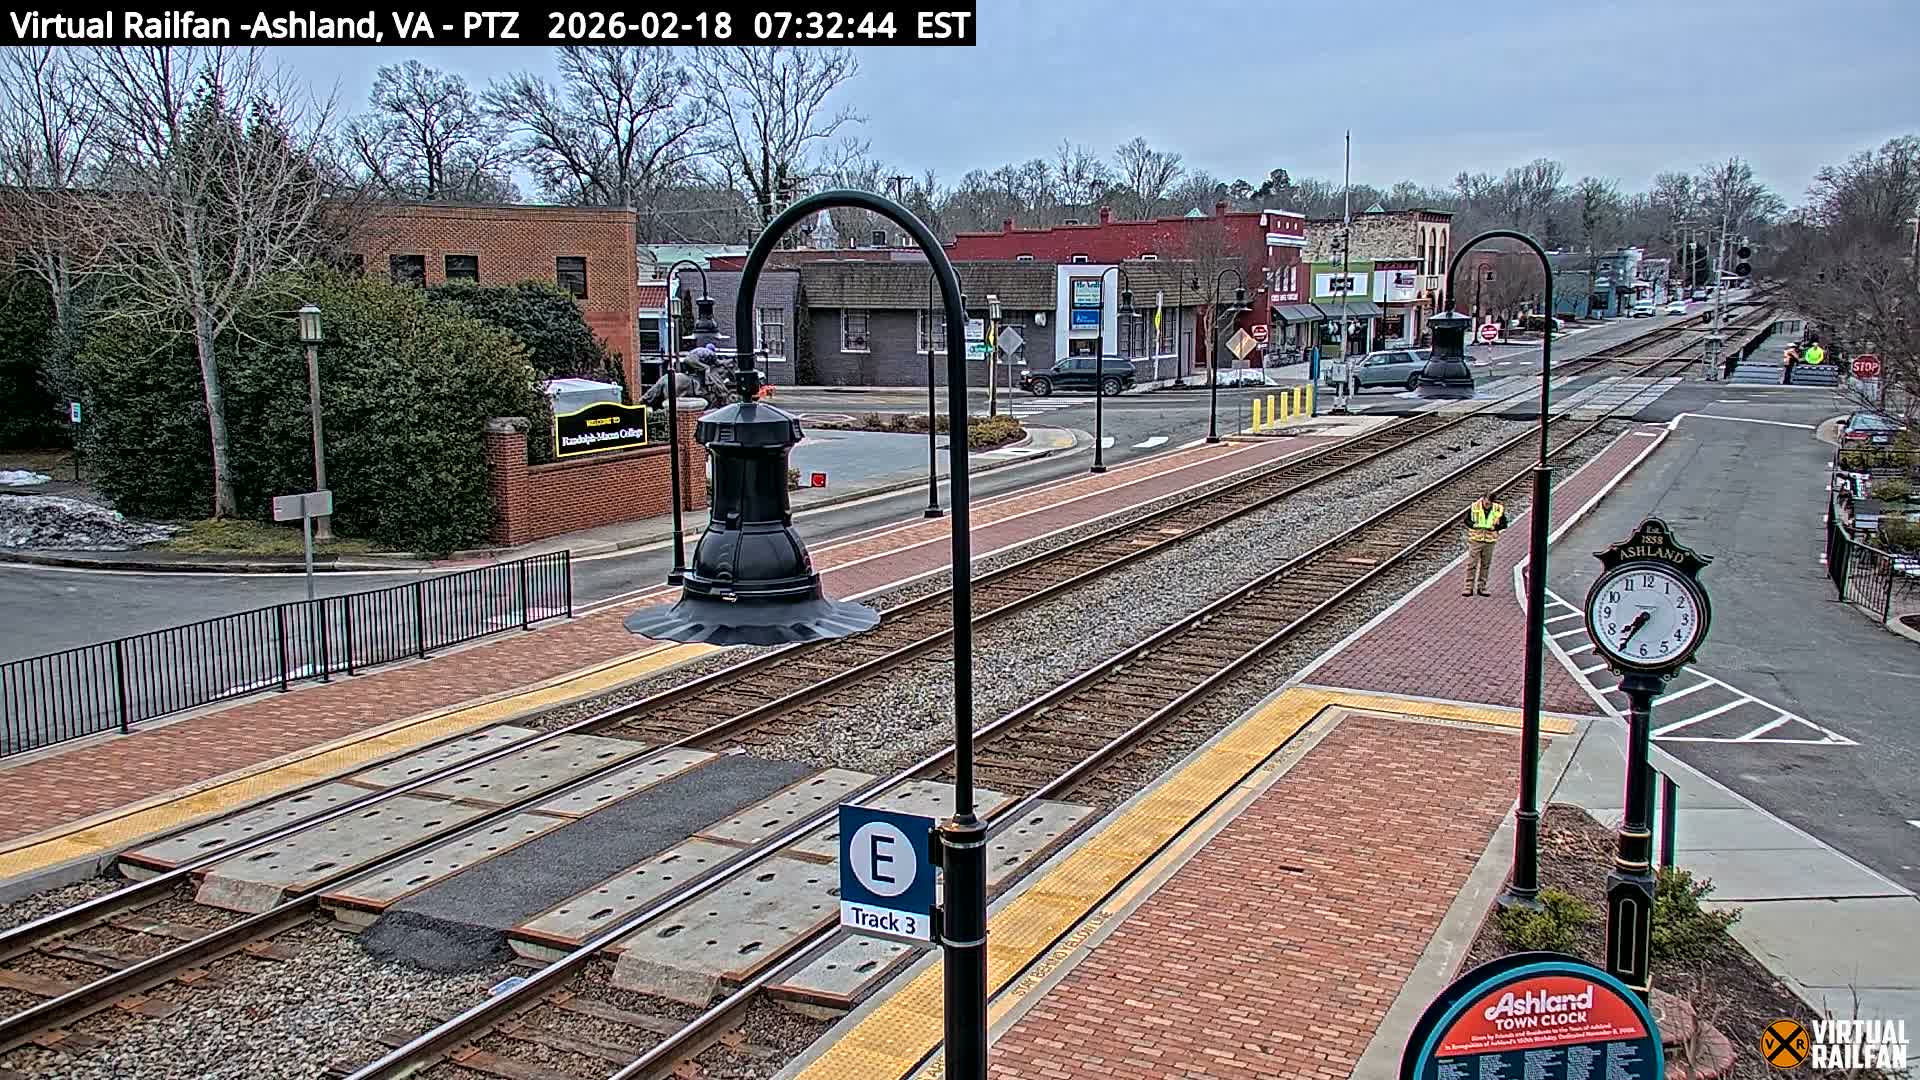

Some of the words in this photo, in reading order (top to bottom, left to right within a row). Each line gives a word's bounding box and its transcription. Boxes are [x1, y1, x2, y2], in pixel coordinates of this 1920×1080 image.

[1852, 361, 1879, 372] STOP
[1641, 535, 1664, 545] 1858
[1619, 546, 1685, 564] ASHLAND
[1625, 578, 1634, 592] 11
[1643, 575, 1655, 588] 12
[1664, 582, 1670, 595] 1
[1609, 591, 1621, 604] 10
[1676, 596, 1685, 609] 2
[1603, 606, 1612, 619] 9
[1681, 613, 1689, 627] 3
[1607, 622, 1617, 636] 8
[1673, 628, 1682, 642] 4
[1639, 643, 1648, 656] 6
[1659, 641, 1669, 653] 5
[870, 834, 895, 884] E
[851, 906, 900, 932] Track
[905, 916, 916, 936] 3
[1484, 984, 1594, 1021] Ashland
[1495, 1015, 1538, 1030] TOWN
[1541, 1011, 1587, 1026] CLOCK
